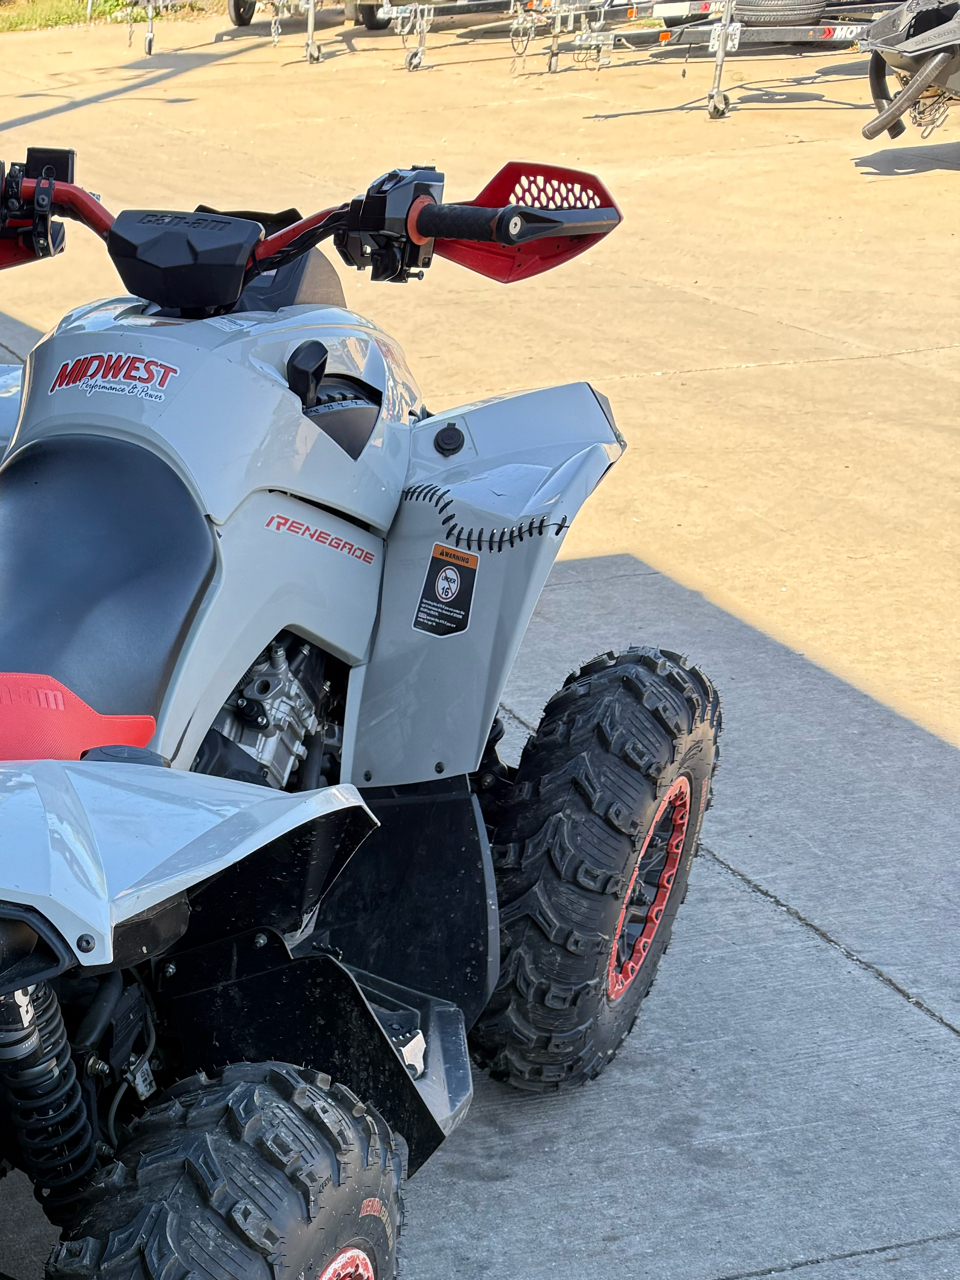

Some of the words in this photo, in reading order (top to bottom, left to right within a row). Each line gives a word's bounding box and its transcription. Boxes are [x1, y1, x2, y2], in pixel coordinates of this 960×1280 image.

[50, 354, 177, 393] MIDWEST
[81, 378, 126, 394] Performance
[139, 386, 163, 401] Power
[265, 514, 375, 565] RENEGADE
[444, 551, 470, 564] WARNING
[441, 586, 450, 597] 16
